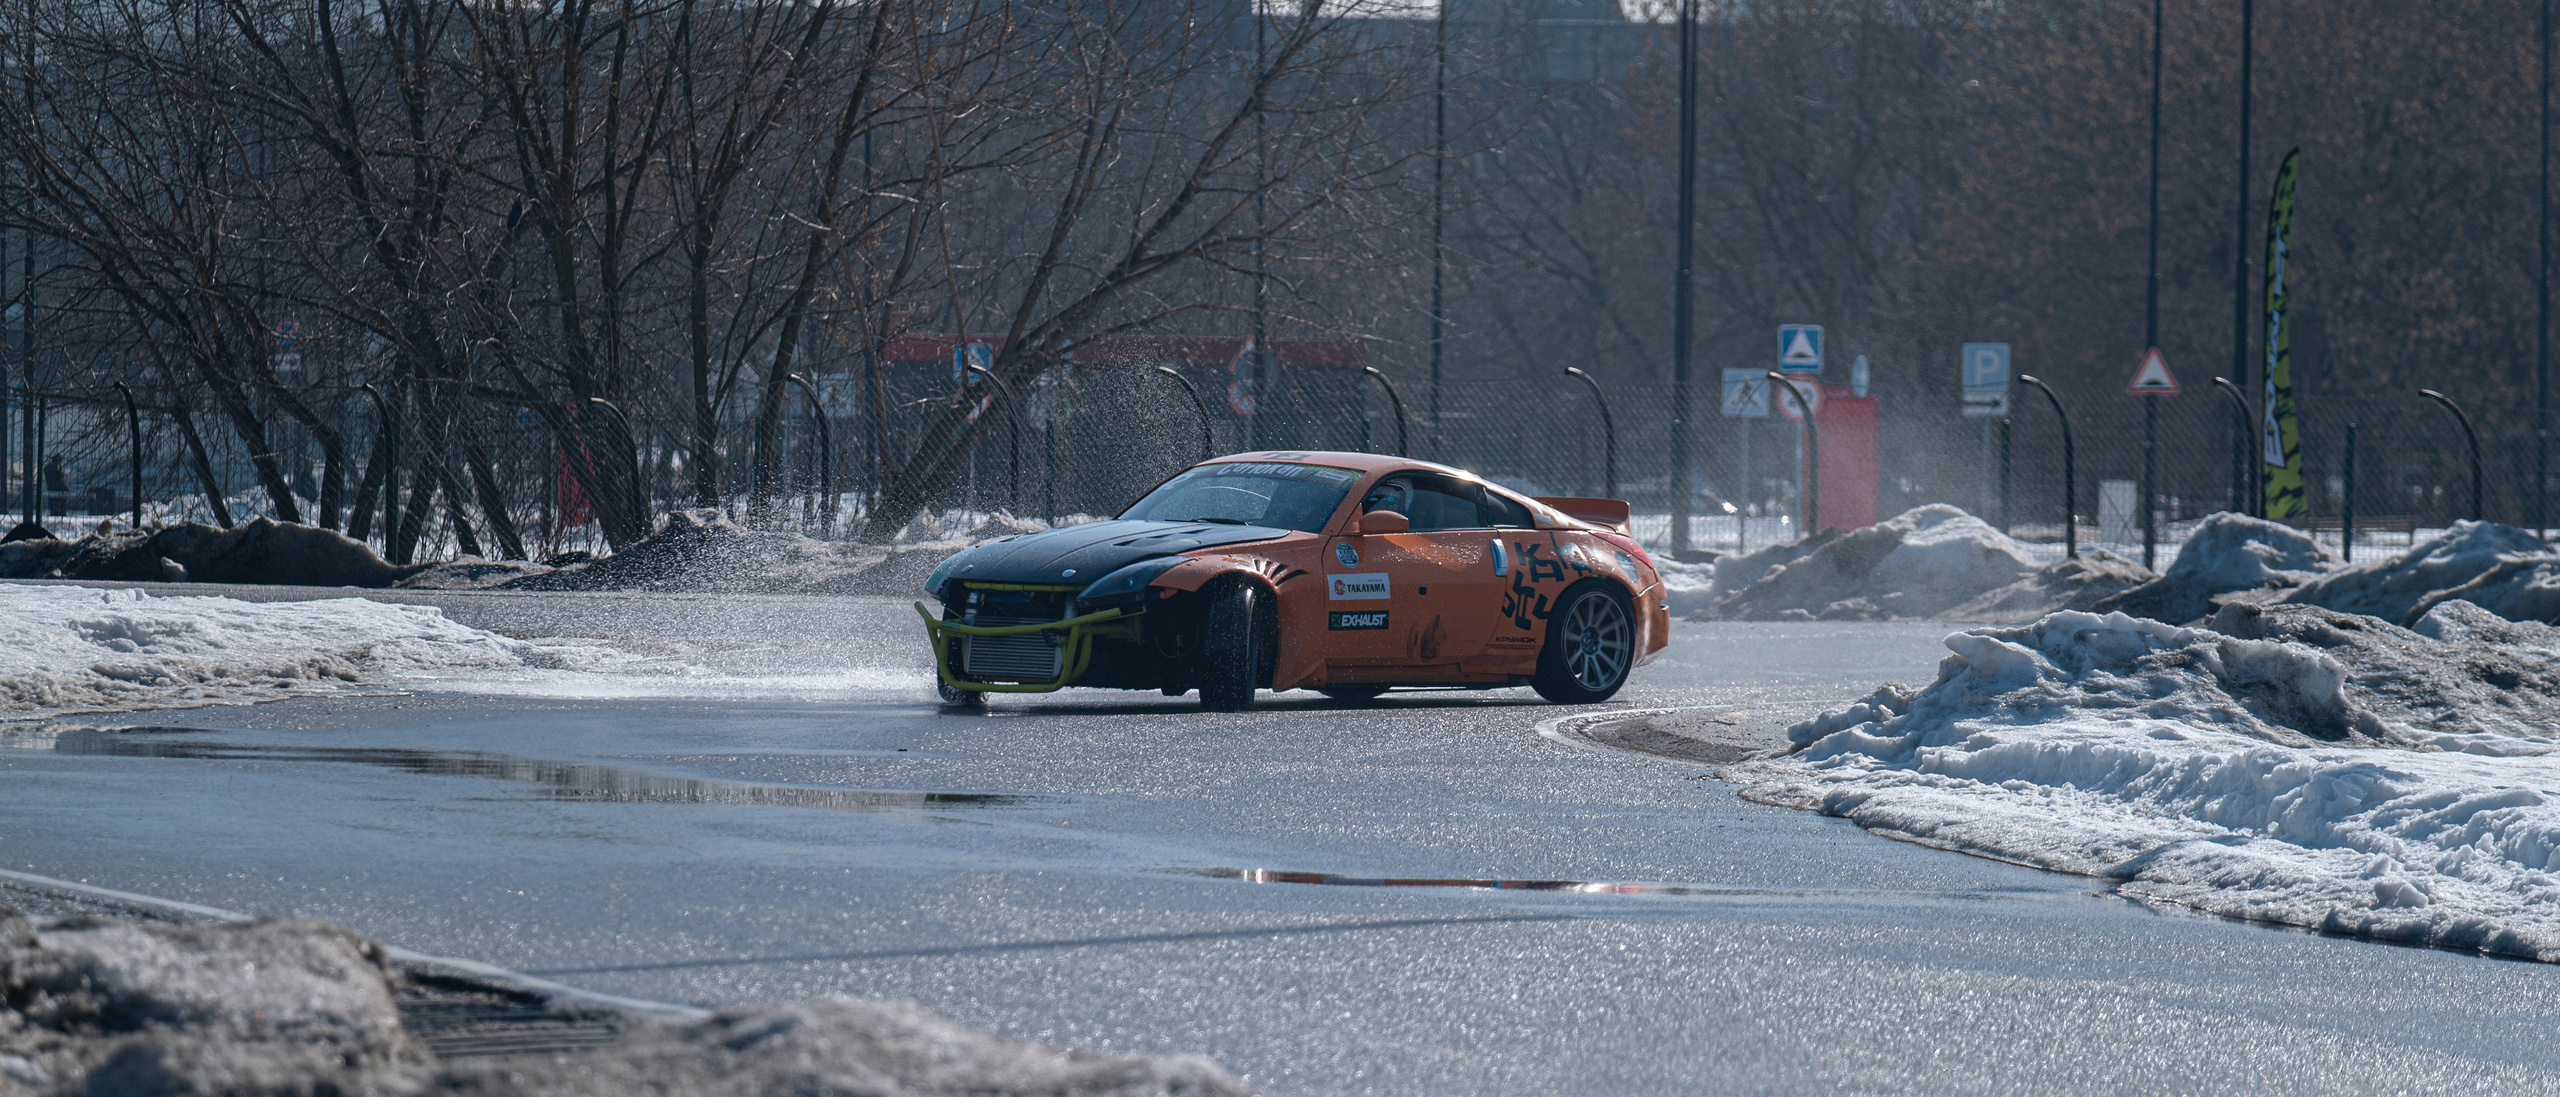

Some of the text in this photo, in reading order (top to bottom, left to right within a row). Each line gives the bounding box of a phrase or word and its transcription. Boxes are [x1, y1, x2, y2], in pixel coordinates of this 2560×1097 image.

[1975, 350, 2000, 386] P
[1347, 583, 1386, 593] TAKAYAMA
[1341, 614, 1387, 627] EXHAUST
